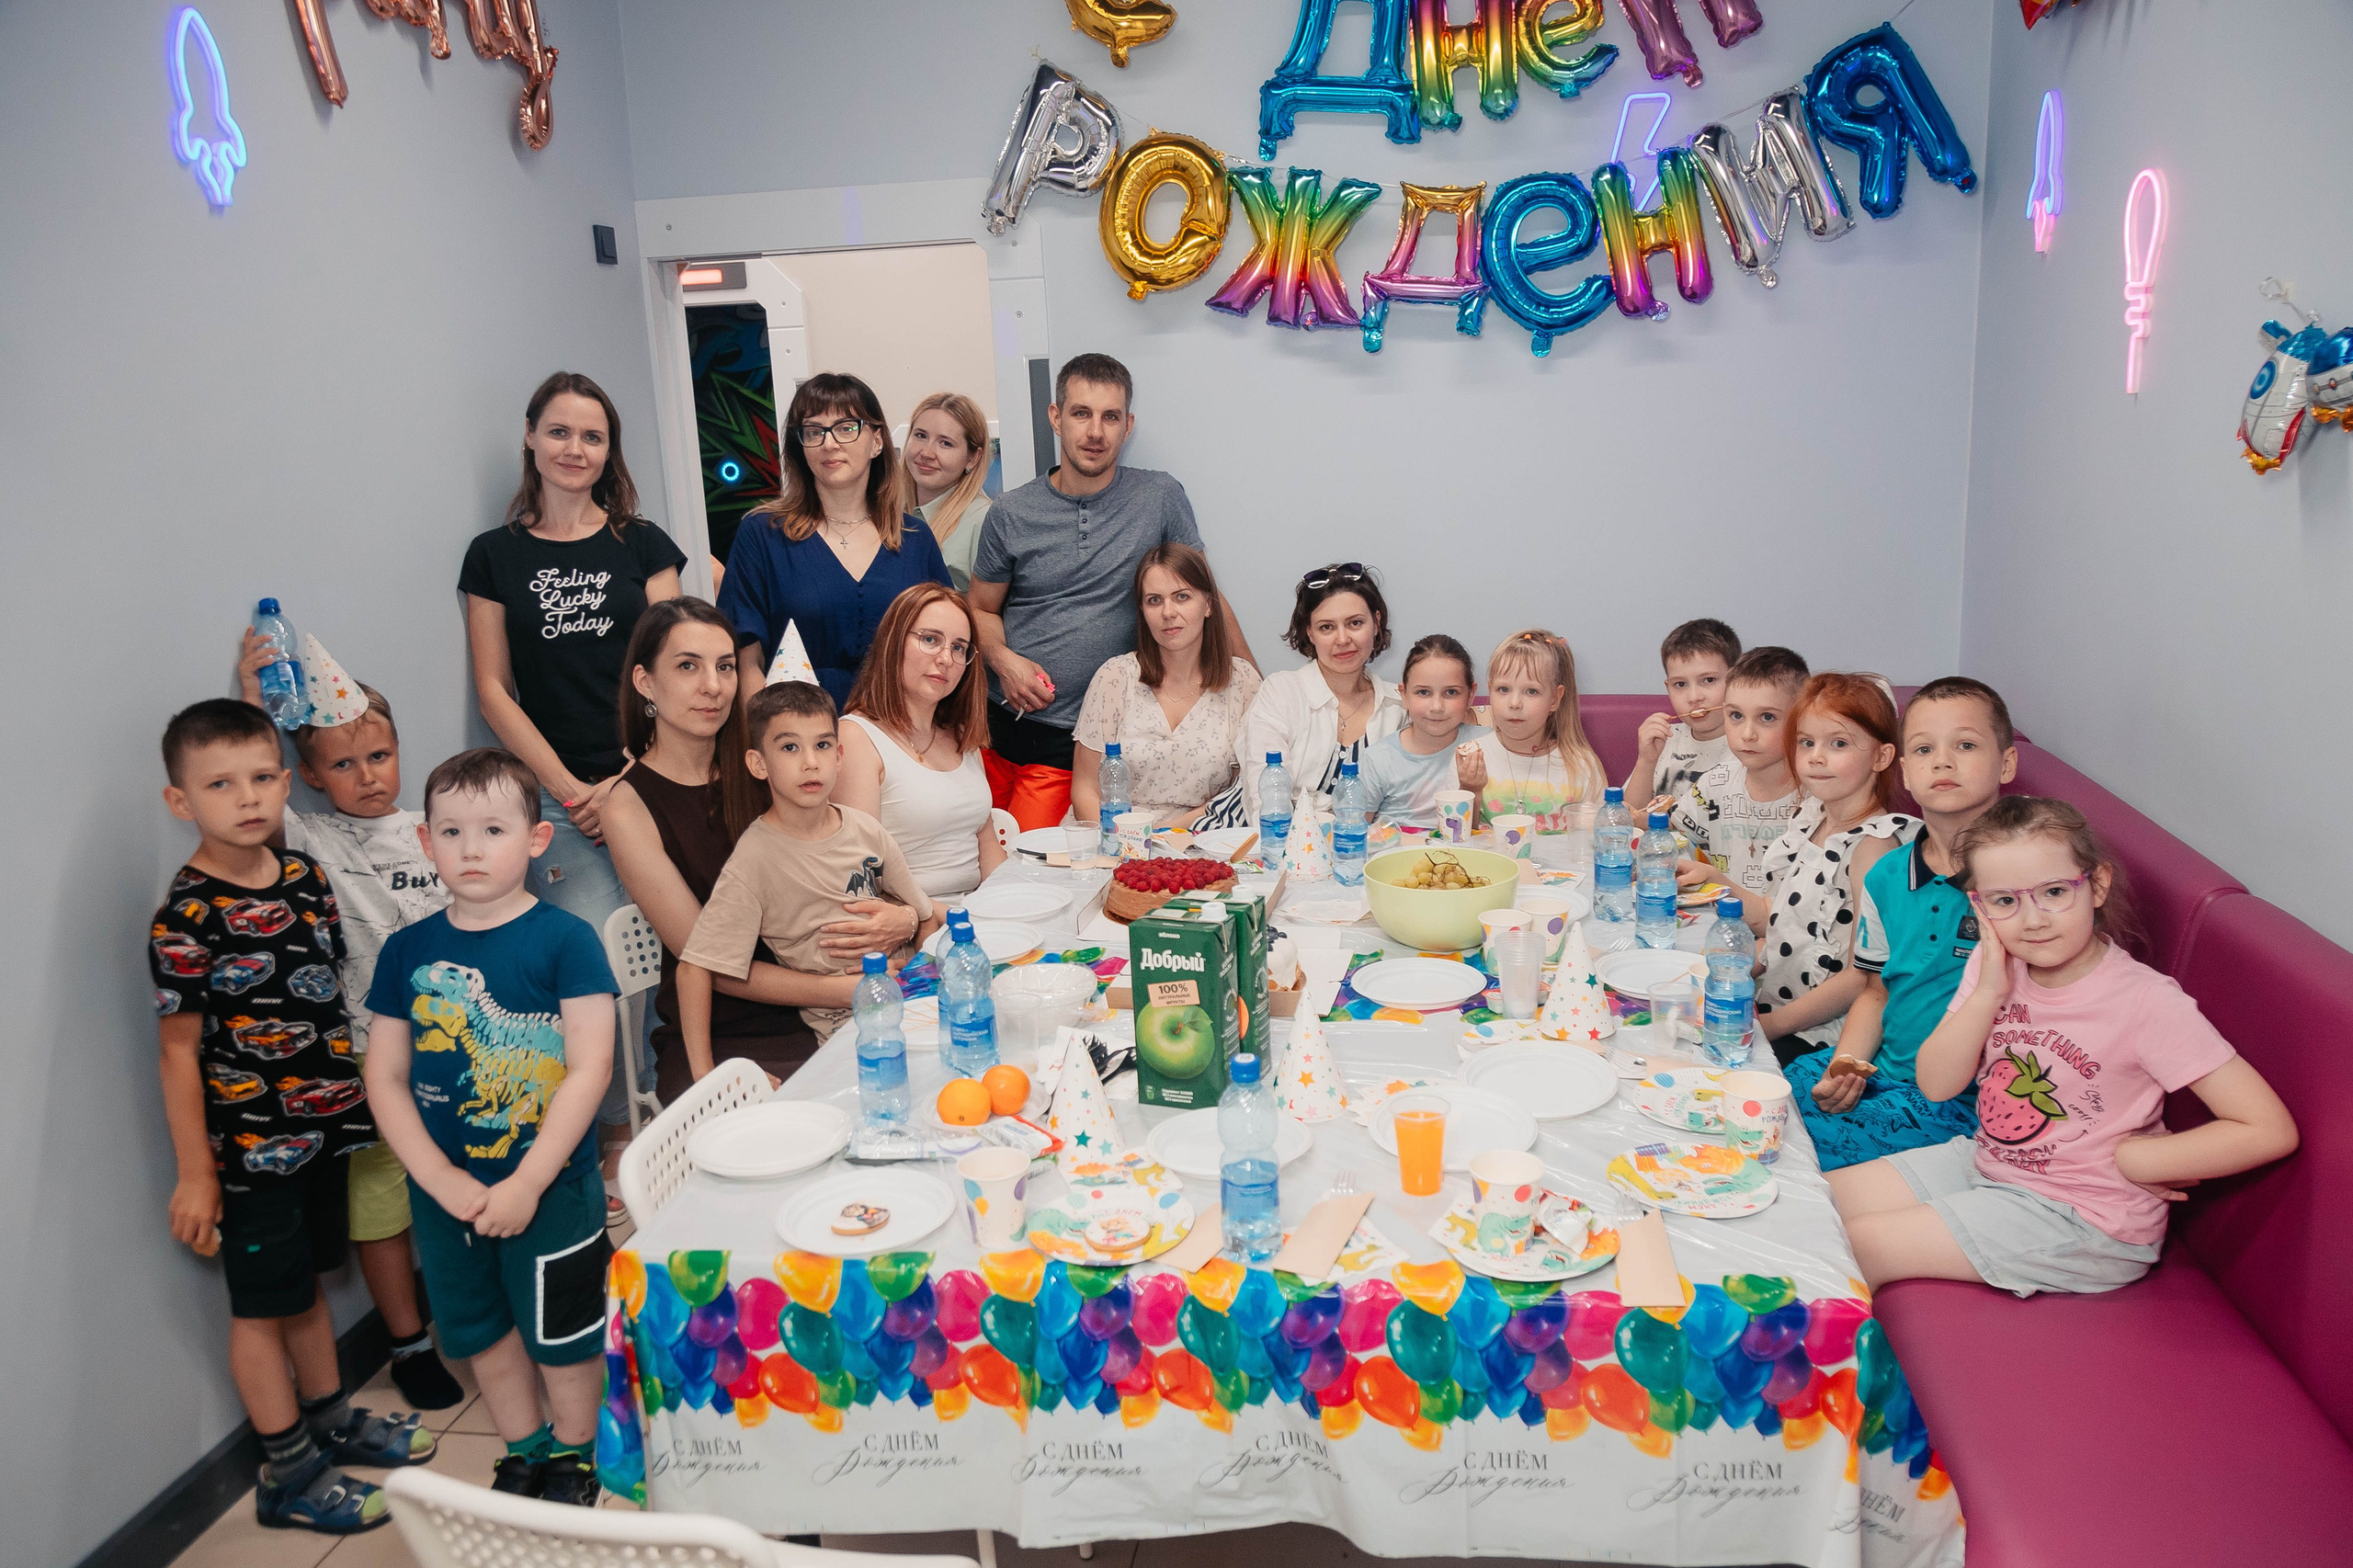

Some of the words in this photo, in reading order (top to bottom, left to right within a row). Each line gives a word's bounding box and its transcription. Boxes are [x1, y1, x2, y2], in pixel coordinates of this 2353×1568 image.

[529, 568, 611, 592] Feeling
[540, 587, 607, 611] Lucky
[541, 607, 614, 639] Today
[1141, 948, 1205, 972] Добрый
[1993, 1029, 2101, 1079] SOMETHING
[865, 1434, 877, 1452] С
[1042, 1441, 1056, 1460] С
[1463, 1452, 1477, 1470] С
[1481, 1449, 1548, 1471] ДНЁМ
[1694, 1460, 1710, 1480] С
